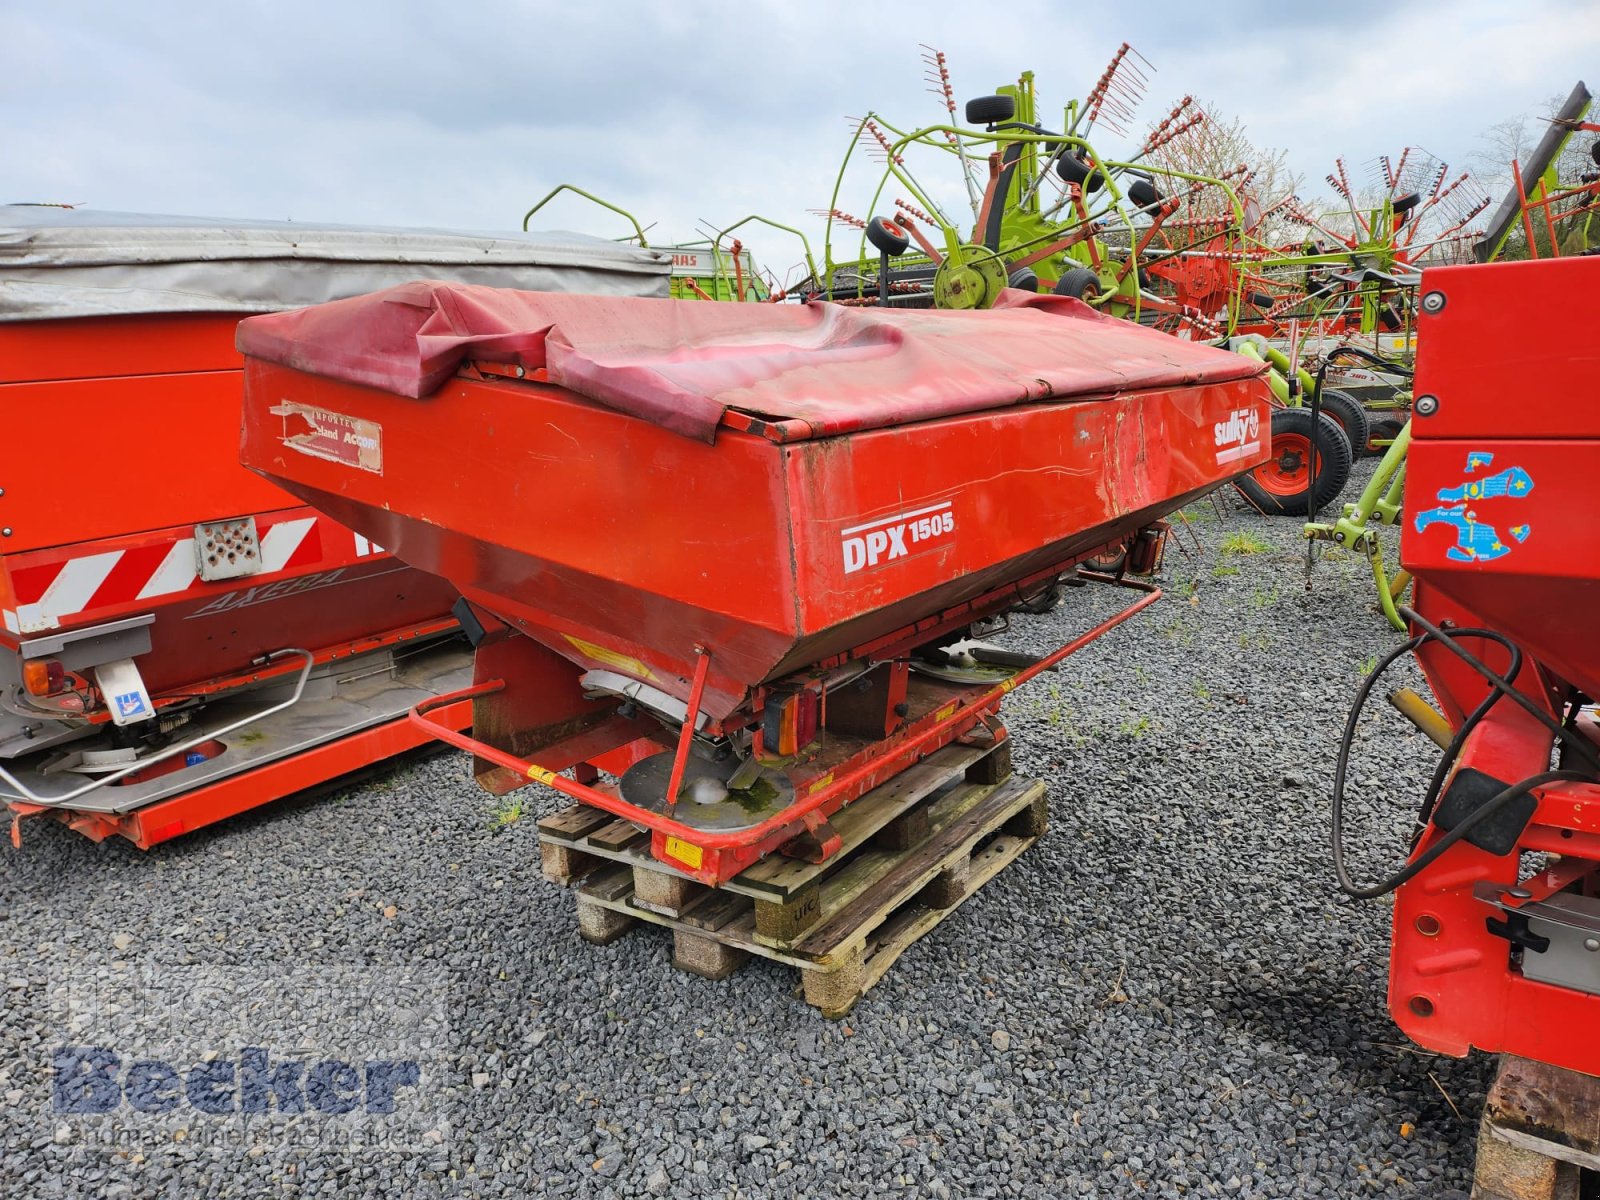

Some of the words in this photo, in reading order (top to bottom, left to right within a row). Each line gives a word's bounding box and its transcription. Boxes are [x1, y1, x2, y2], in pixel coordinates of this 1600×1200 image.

[671, 254, 697, 266] AAS
[1215, 411, 1250, 446] sulky
[842, 525, 908, 575] DPX
[908, 511, 955, 543] 1505
[193, 568, 346, 614] AXERA
